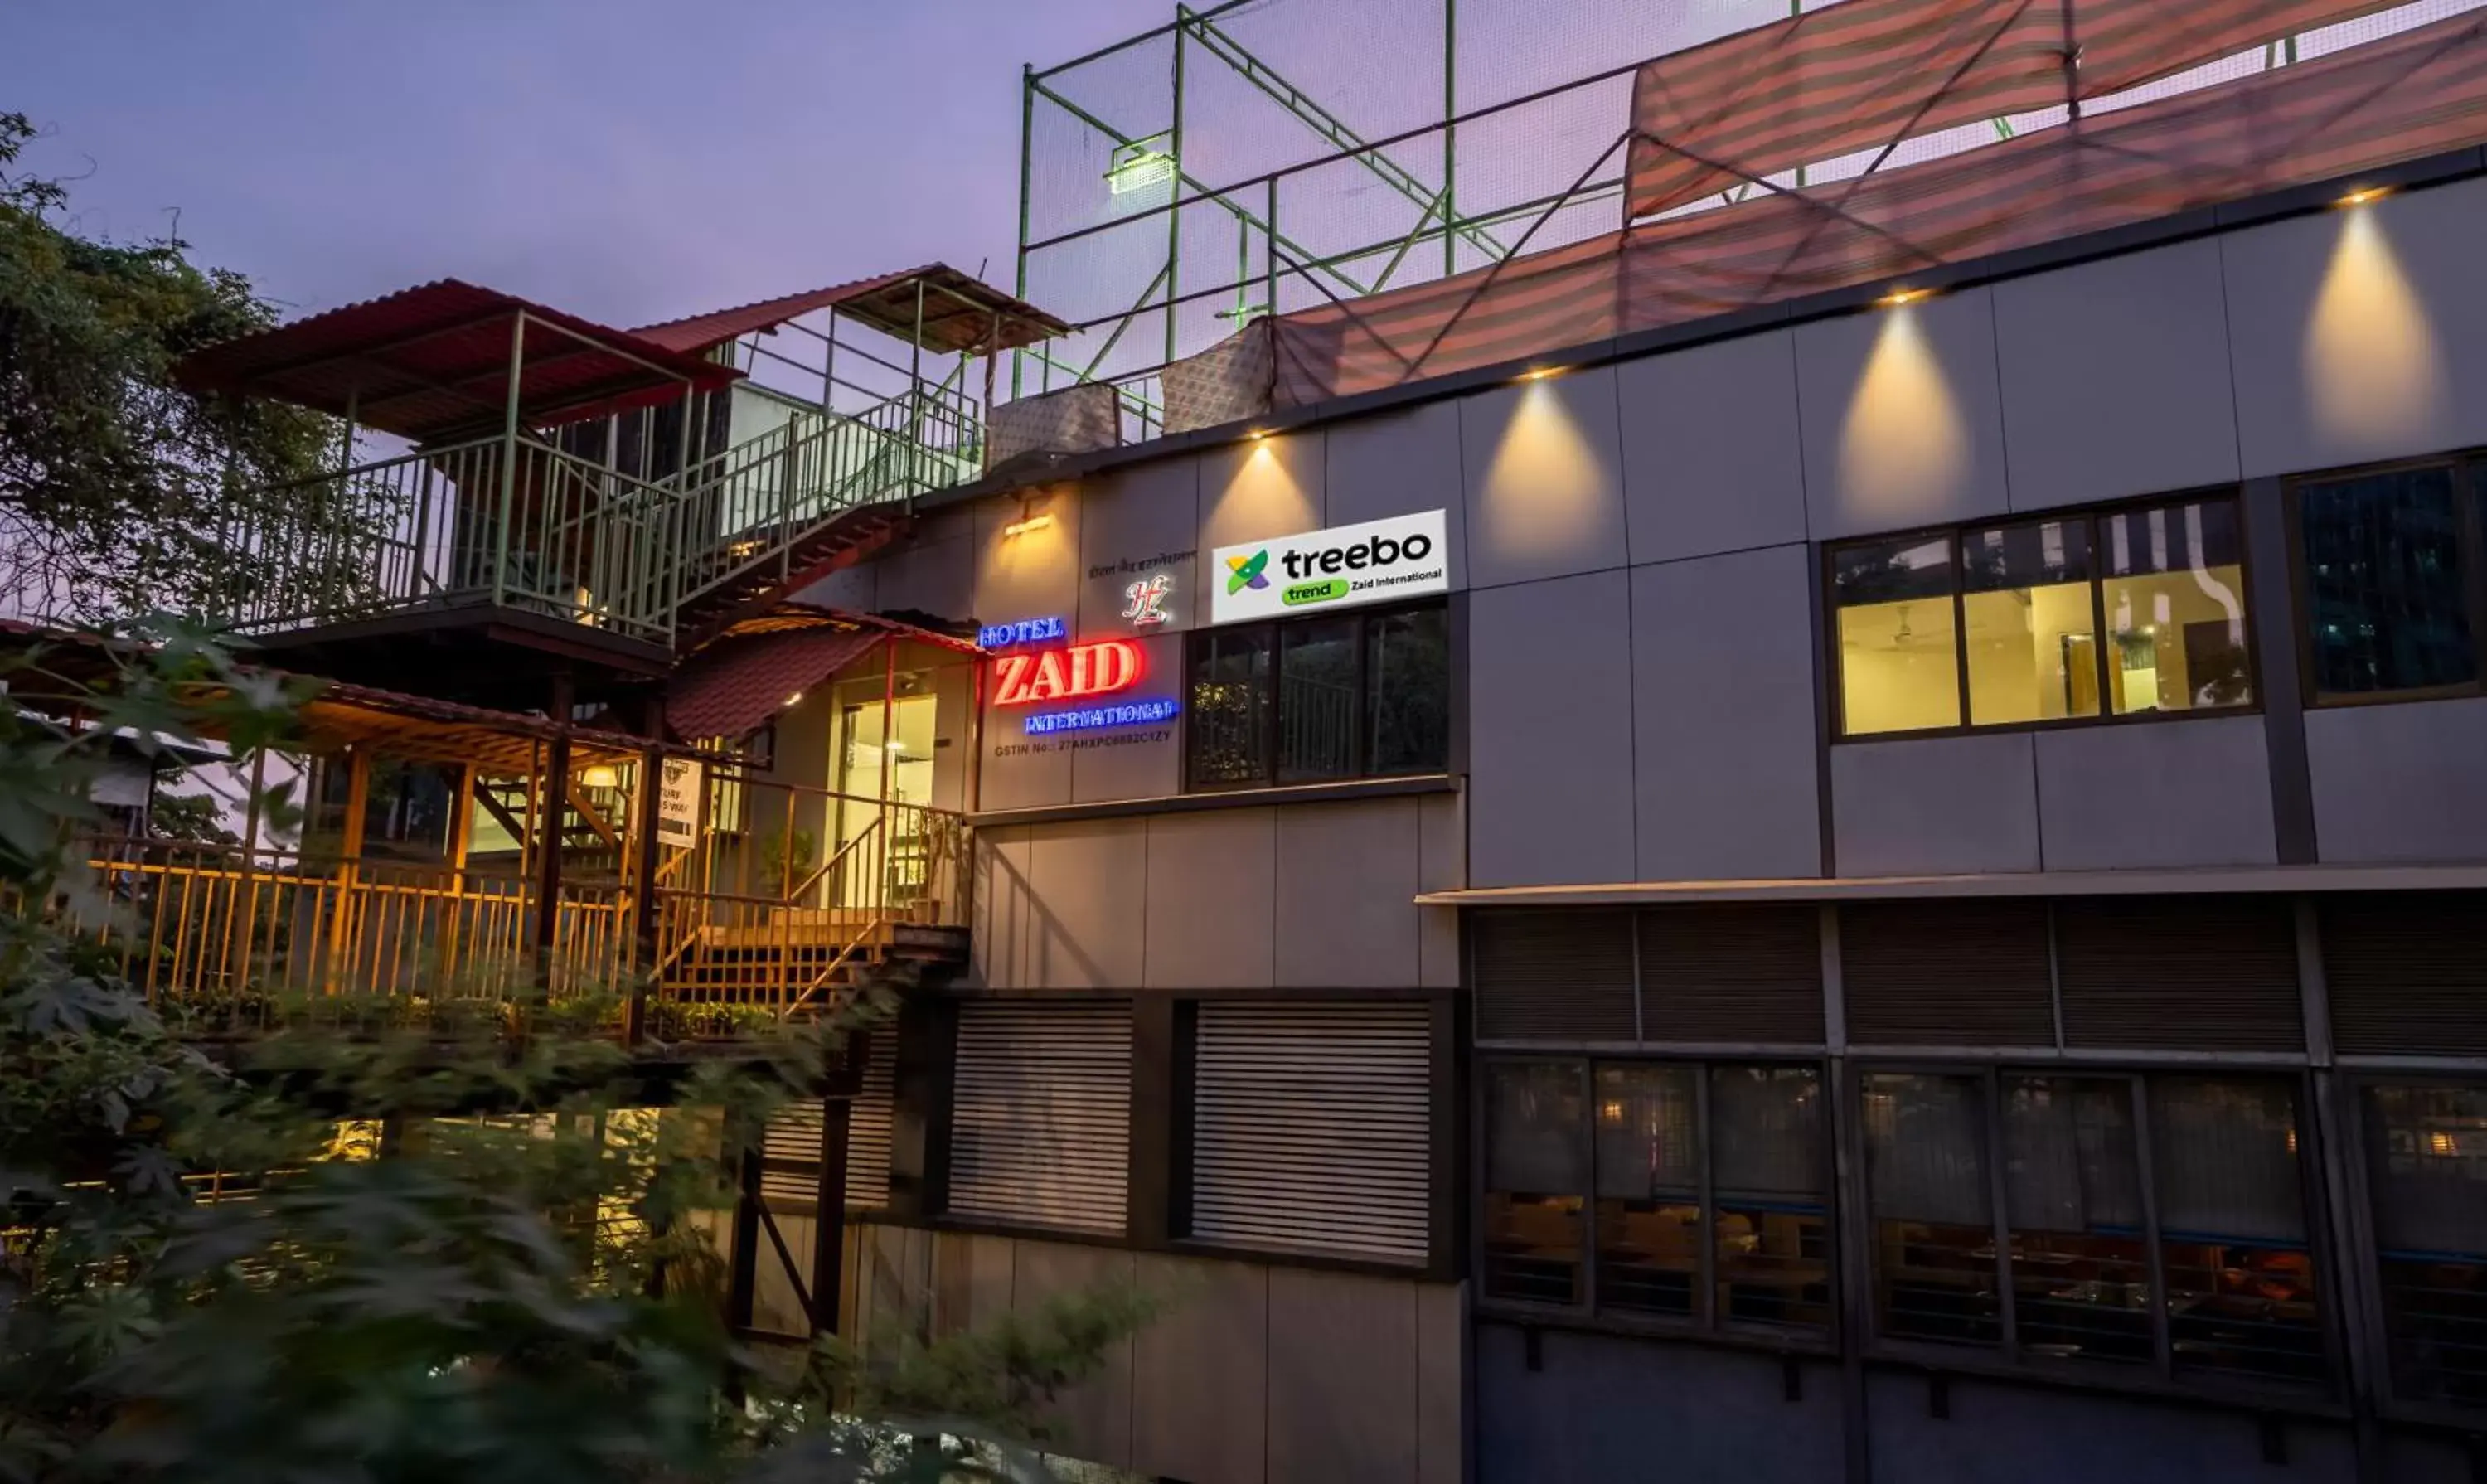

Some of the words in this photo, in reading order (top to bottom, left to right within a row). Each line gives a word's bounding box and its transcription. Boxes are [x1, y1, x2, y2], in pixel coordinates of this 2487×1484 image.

[1282, 534, 1432, 579] treebo
[1287, 583, 1331, 600] trend
[1350, 580, 1374, 592] Zaid
[1376, 568, 1442, 587] International
[979, 617, 1064, 647] HOTEL
[994, 642, 1137, 705] ZAID
[1024, 701, 1175, 734] INTERNATIONAL
[995, 743, 1029, 757] GSTIN
